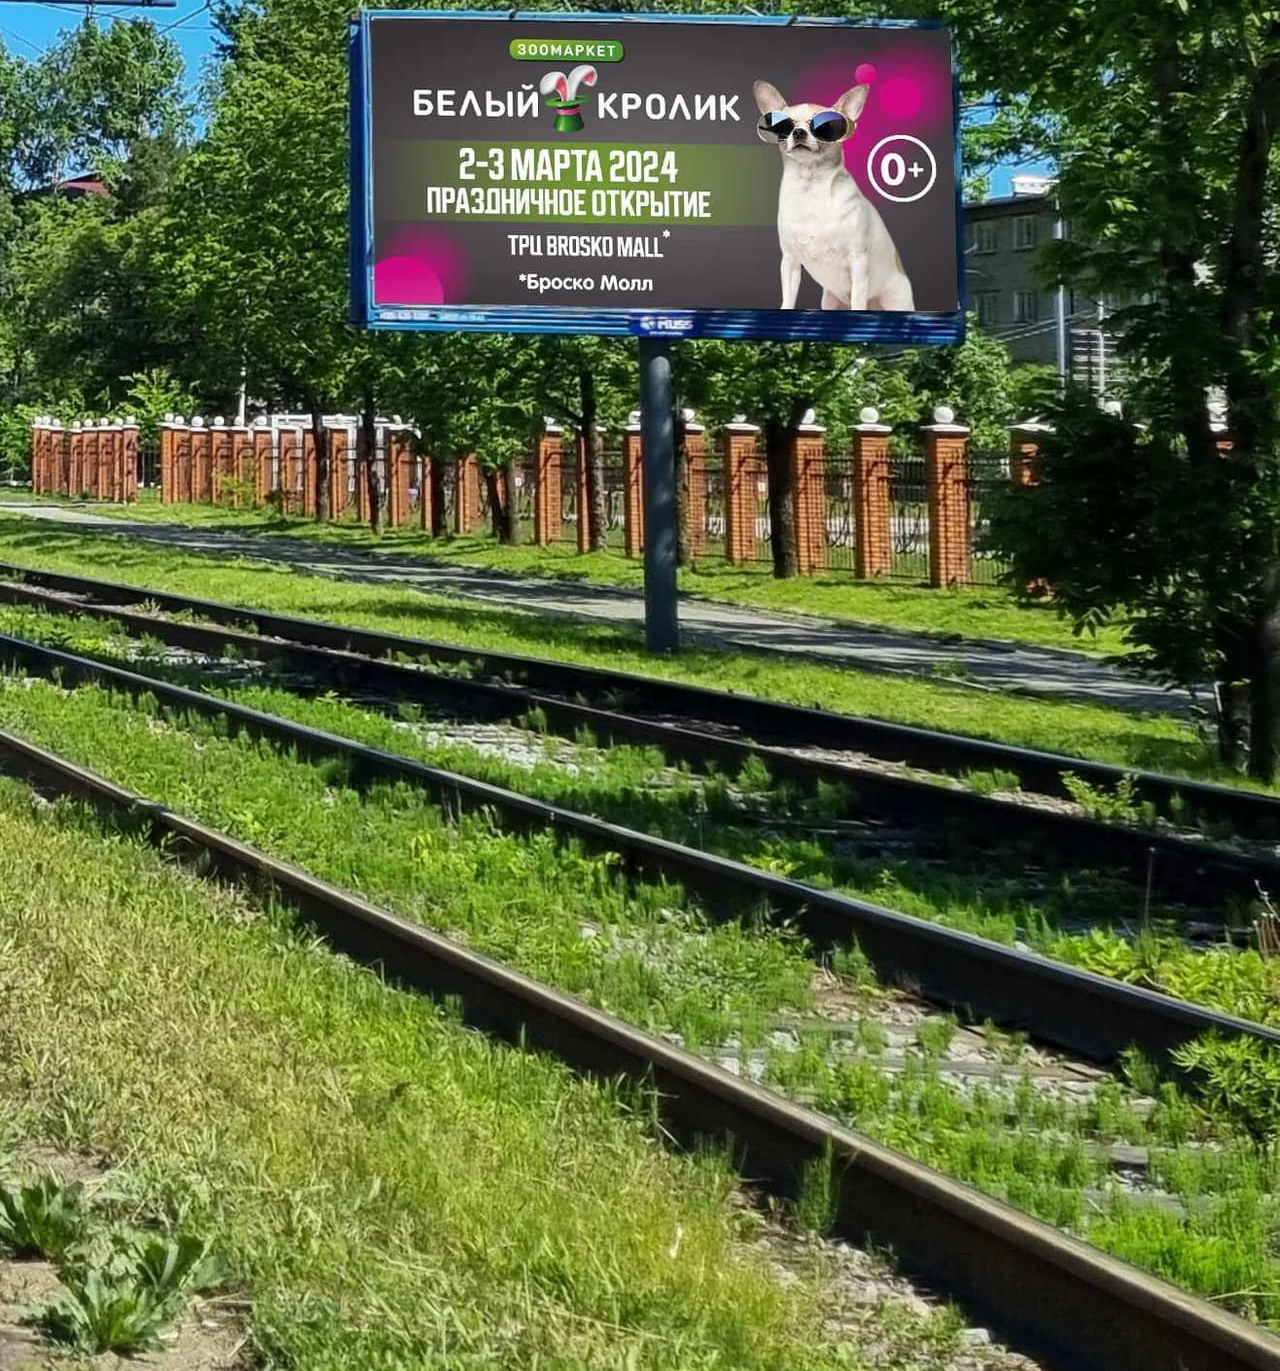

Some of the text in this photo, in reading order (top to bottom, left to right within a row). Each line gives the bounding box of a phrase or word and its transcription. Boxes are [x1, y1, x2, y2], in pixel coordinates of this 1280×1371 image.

[517, 43, 617, 57] ЗООМАРКЕТ
[413, 83, 740, 122] БЕЛЫЙ КРОЛИК
[458, 147, 679, 183] 2-3 МАРТА 2024
[880, 152, 924, 186] 0+
[426, 185, 712, 218] ПРАЗДНИЧНОЕ ОТКРЫТИЕ
[507, 234, 543, 257] ТРЦ
[546, 235, 614, 258] BROSKO
[600, 274, 654, 292] Молл
